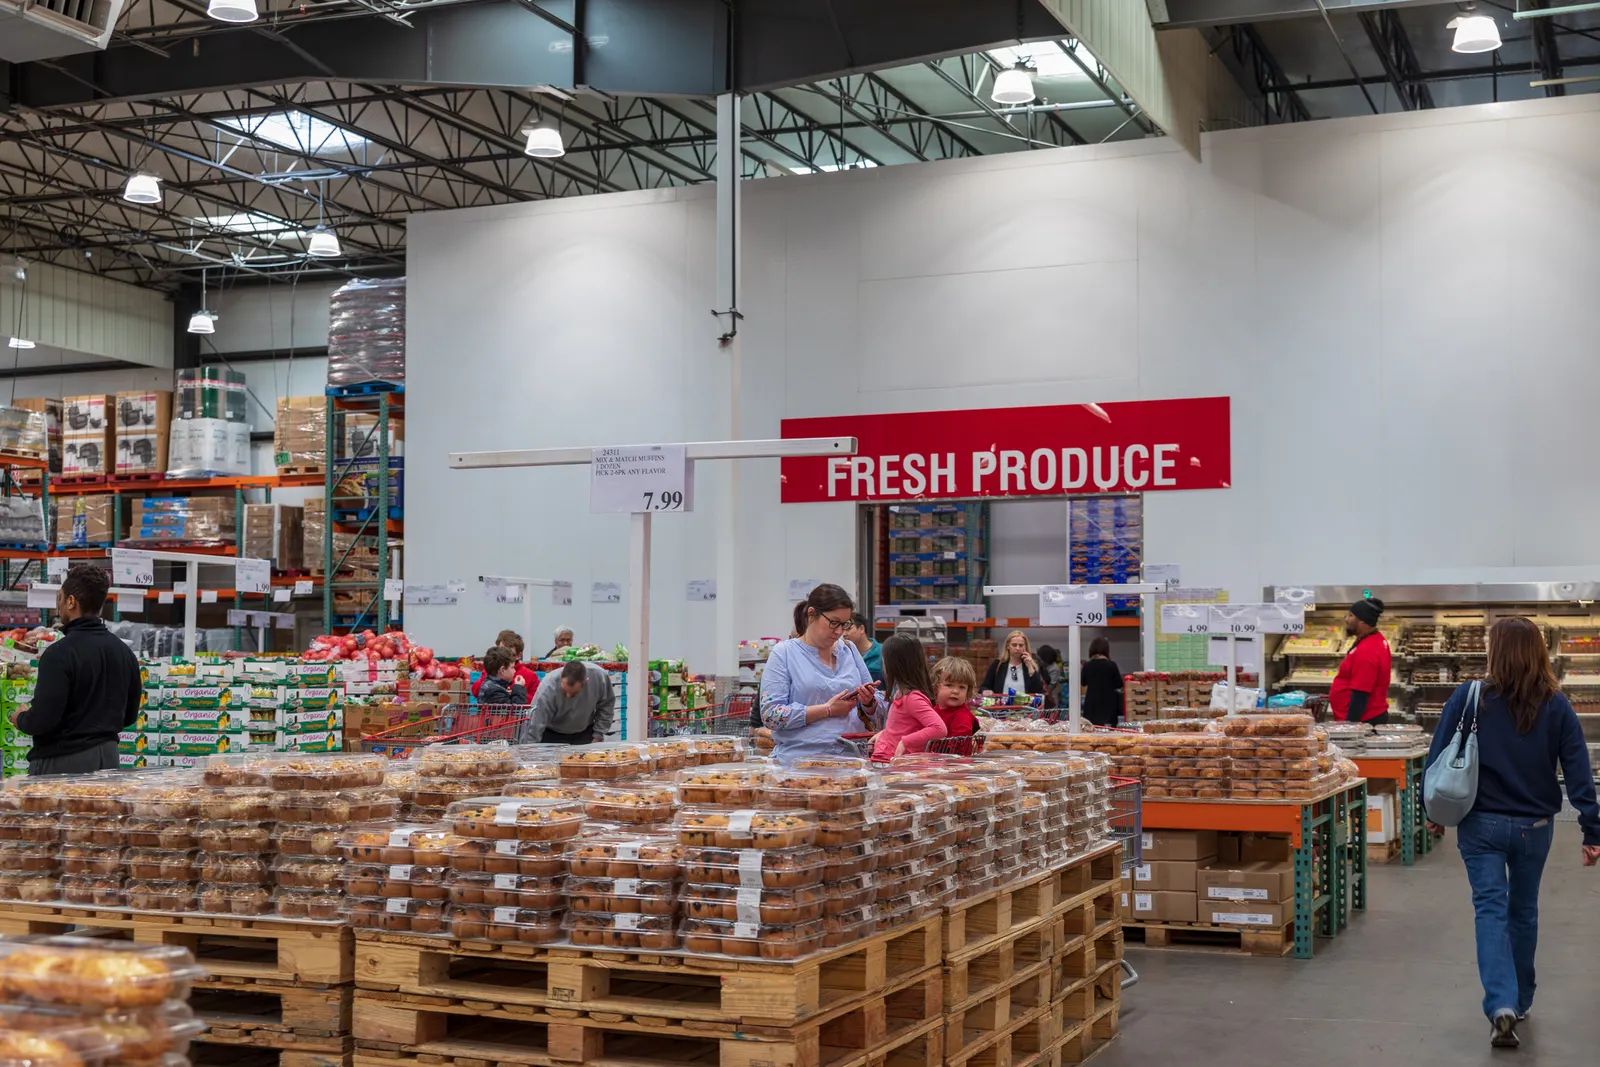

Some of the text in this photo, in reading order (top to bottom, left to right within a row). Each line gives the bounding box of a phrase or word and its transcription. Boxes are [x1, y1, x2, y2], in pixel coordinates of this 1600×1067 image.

[827, 443, 1177, 497] FRESH PRODUCE
[642, 491, 683, 510] 7.99
[136, 574, 152, 584] 6.99
[255, 583, 270, 592] 1.99
[1076, 612, 1102, 624] 5.99
[1187, 624, 1208, 633] 4.99
[1230, 624, 1255, 632] 10.99
[1282, 624, 1304, 632] 9.99
[302, 666, 326, 674] Organic
[185, 688, 218, 697] Organic
[304, 689, 328, 698] Organic
[184, 712, 217, 720] Organic
[303, 712, 327, 722] Organic
[182, 734, 216, 743] Organic
[302, 734, 326, 743] Organic
